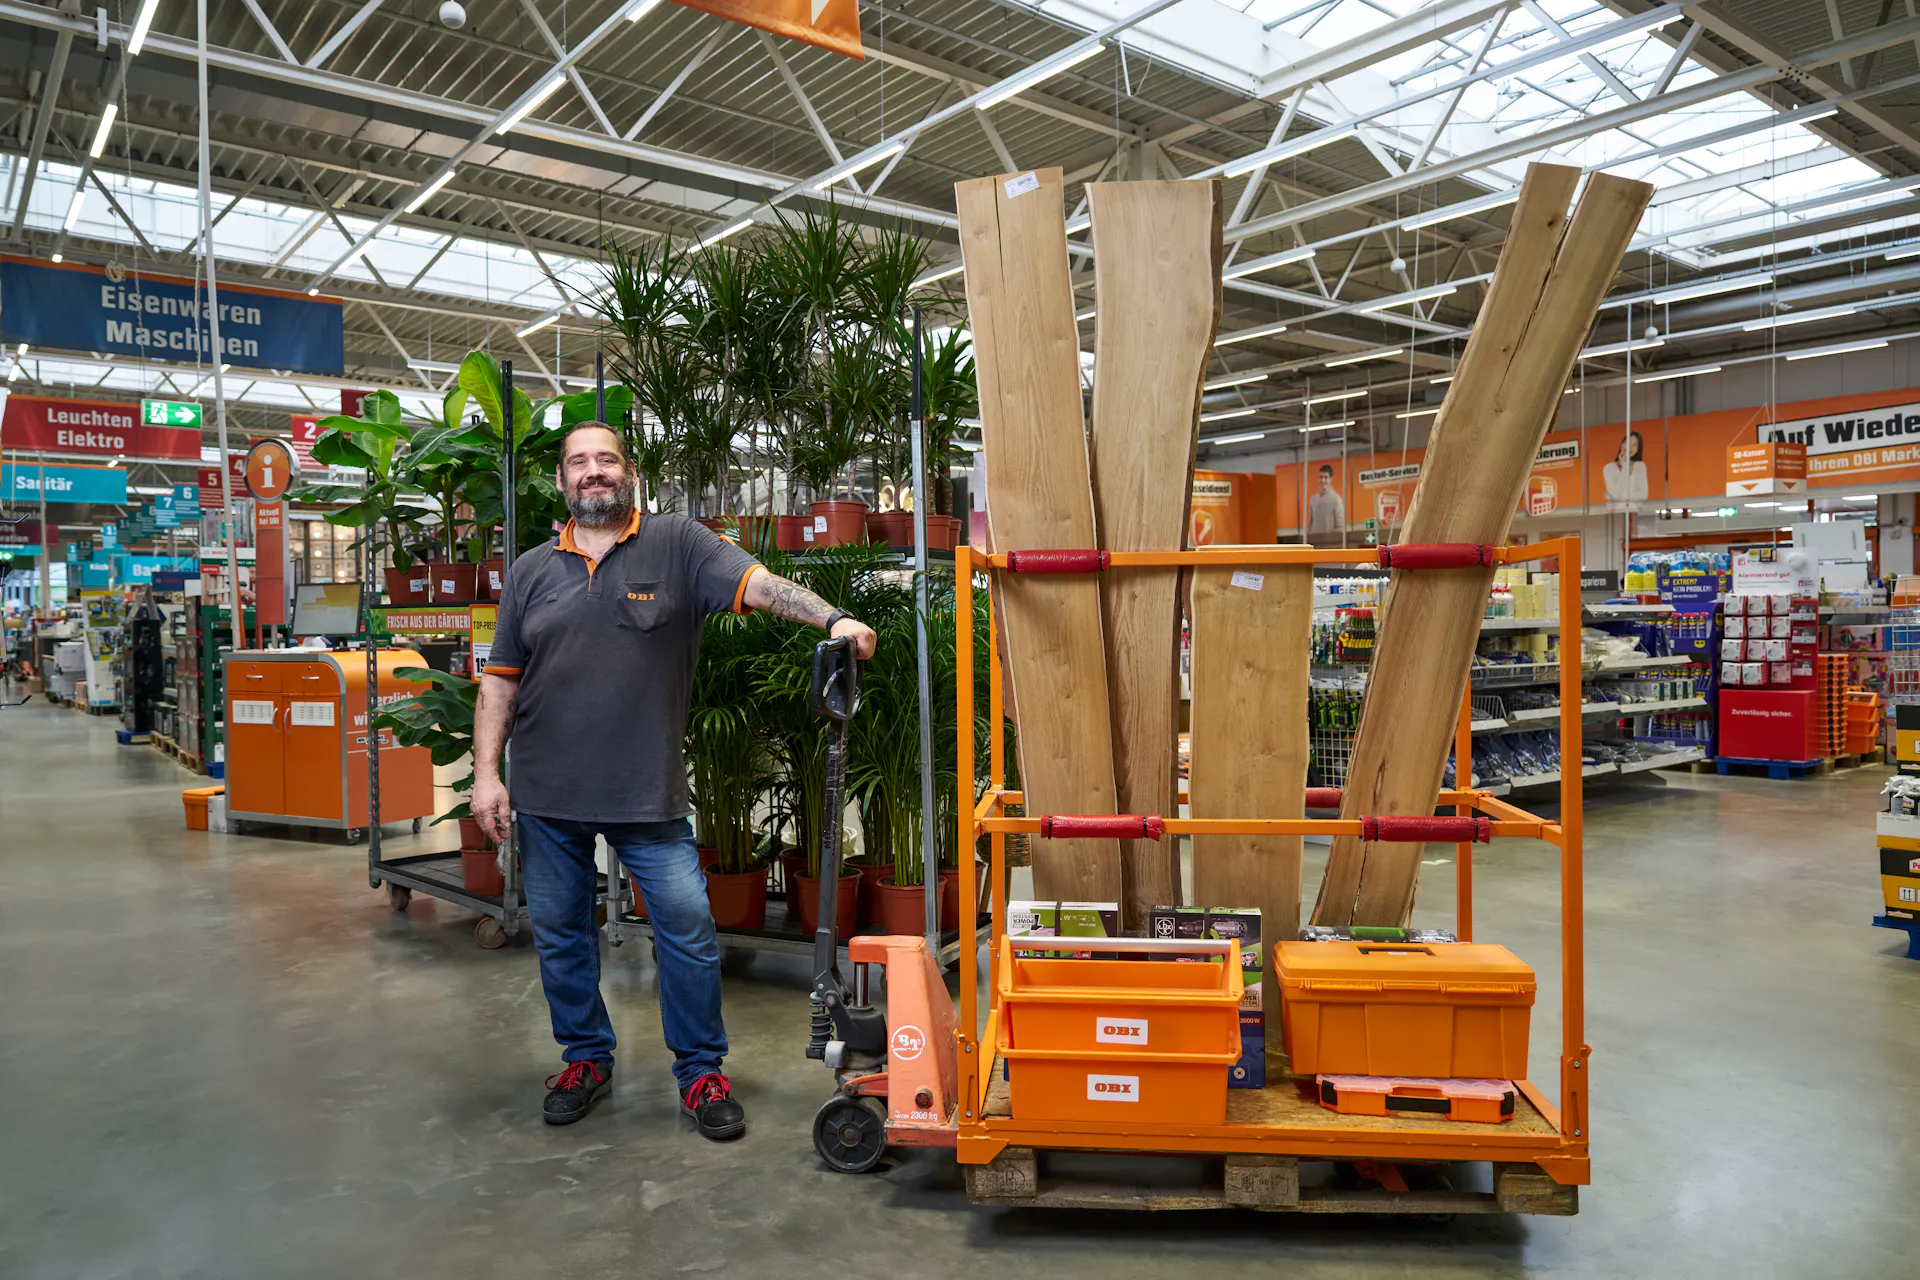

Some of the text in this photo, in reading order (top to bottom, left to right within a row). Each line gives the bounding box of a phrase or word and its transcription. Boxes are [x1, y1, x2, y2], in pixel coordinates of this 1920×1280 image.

[101, 285, 261, 325] Eisenwaren
[48, 408, 132, 428] Leuchten
[304, 422, 316, 439] 2
[57, 430, 124, 449] Elektro
[234, 459, 243, 473] 4
[1809, 457, 1849, 472] Ihrem
[1853, 454, 1877, 466] OBI
[208, 473, 217, 486] 5
[1360, 467, 1418, 481] Bestell-Service
[183, 487, 192, 499] 6
[163, 497, 172, 508] 7
[258, 508, 279, 516] Aktuell
[132, 563, 160, 577] Bad
[1581, 576, 1607, 588] eparieren
[627, 592, 656, 600] OBI
[387, 612, 470, 628] FRISCH AUS DER GÄRTNER
[1731, 708, 1769, 717] Zuverlässig
[1103, 1025, 1140, 1036] OBI
[1094, 1083, 1131, 1093] OBI
[911, 1111, 928, 1119] 2300
[929, 1112, 938, 1121] kg
